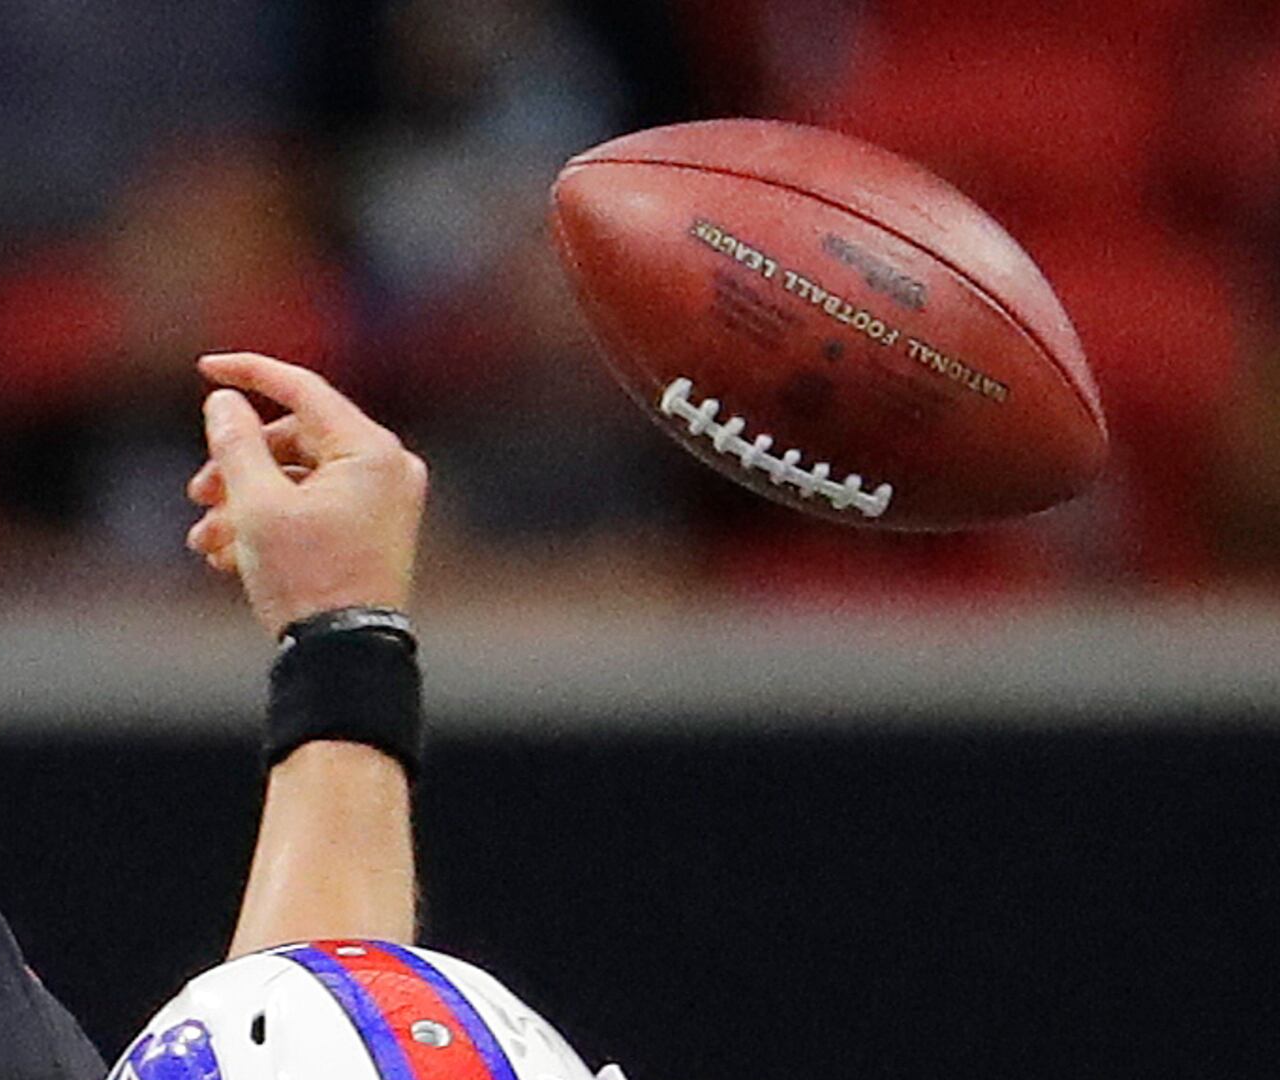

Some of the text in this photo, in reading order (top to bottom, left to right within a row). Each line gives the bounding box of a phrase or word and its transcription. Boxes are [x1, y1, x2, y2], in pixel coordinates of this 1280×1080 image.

[690, 218, 778, 279] LEAGUE
[784, 270, 900, 347] FOOTBALL
[907, 339, 1009, 402] NATIONAL
